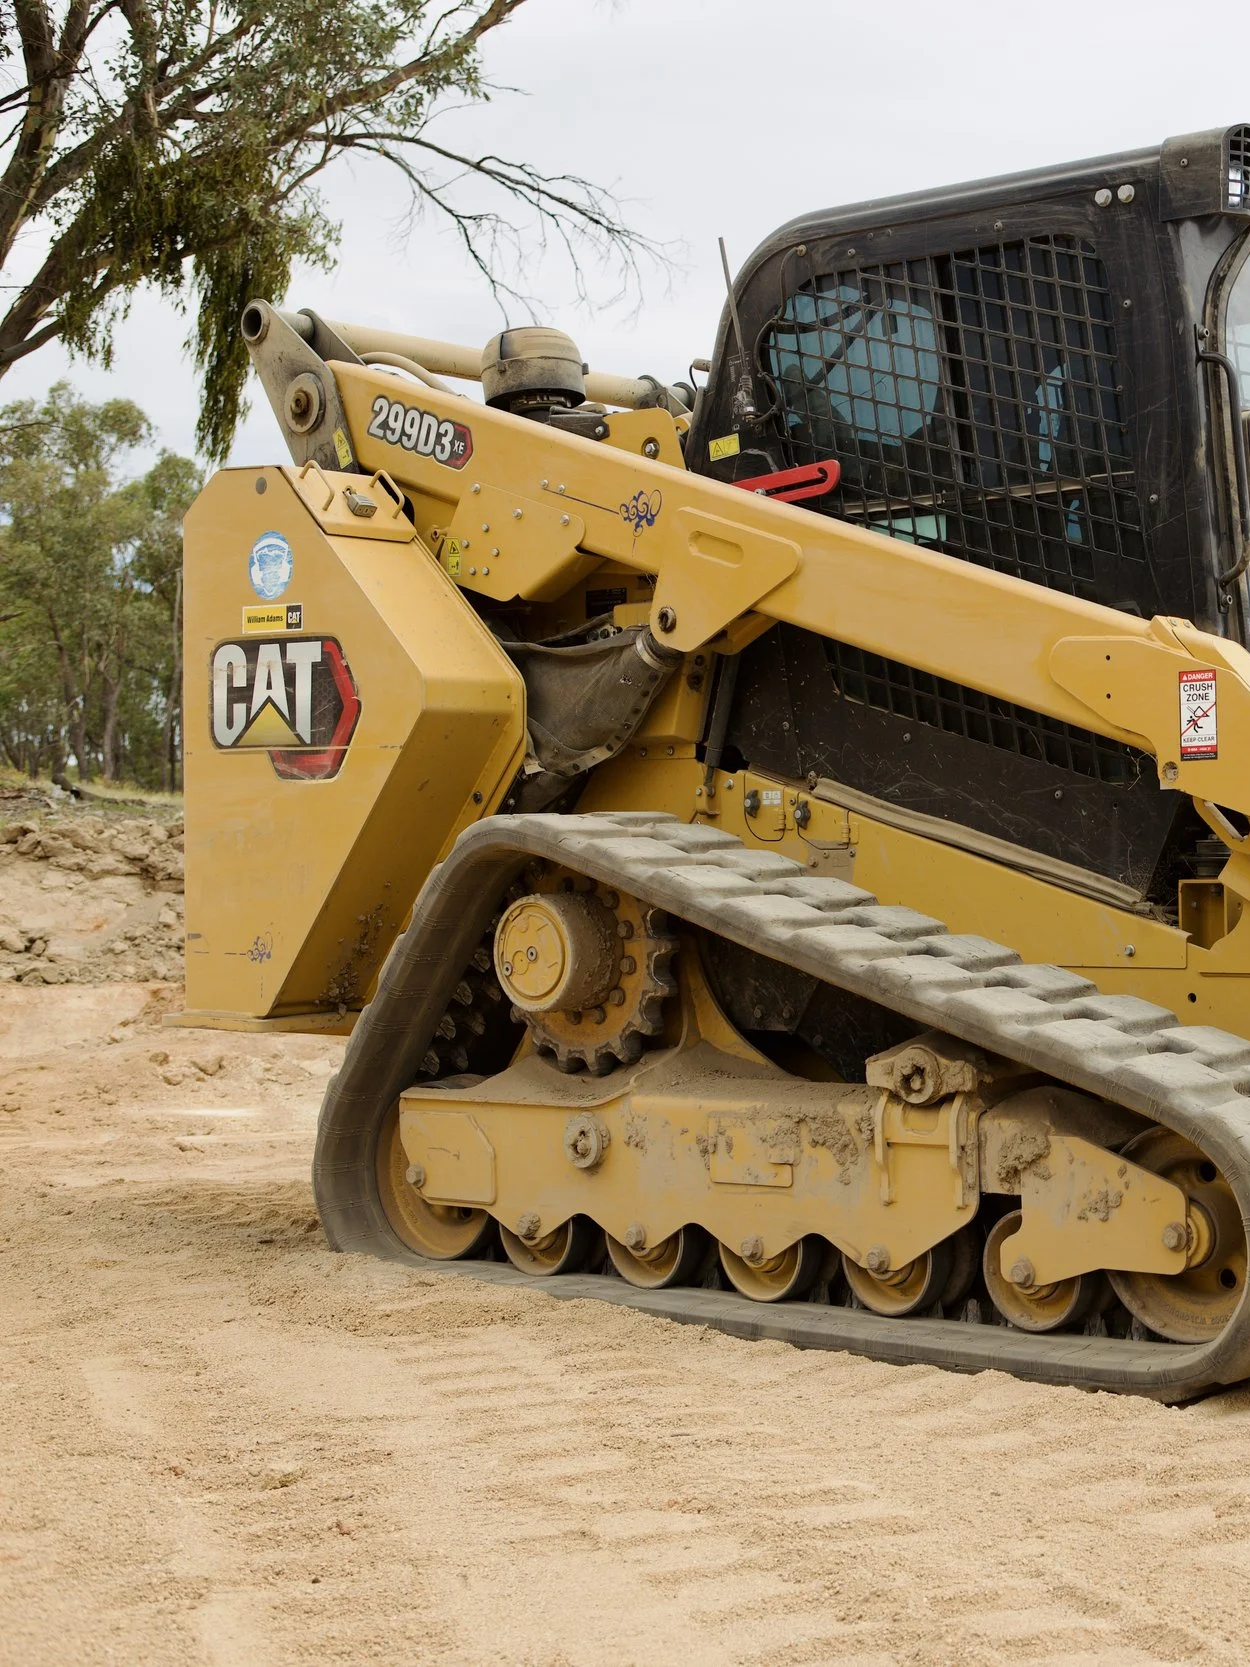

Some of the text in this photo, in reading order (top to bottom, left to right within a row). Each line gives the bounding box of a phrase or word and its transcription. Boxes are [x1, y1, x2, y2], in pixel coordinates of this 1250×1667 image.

[368, 397, 465, 461] 299D3 XE
[247, 614, 284, 624] William Adams
[287, 611, 301, 624] CAT
[1187, 672, 1213, 680] DANGER
[1183, 682, 1213, 693] CRUSH
[213, 641, 322, 746] CAT
[1186, 693, 1210, 702] ZONE
[1197, 735, 1215, 743] CLEAR
